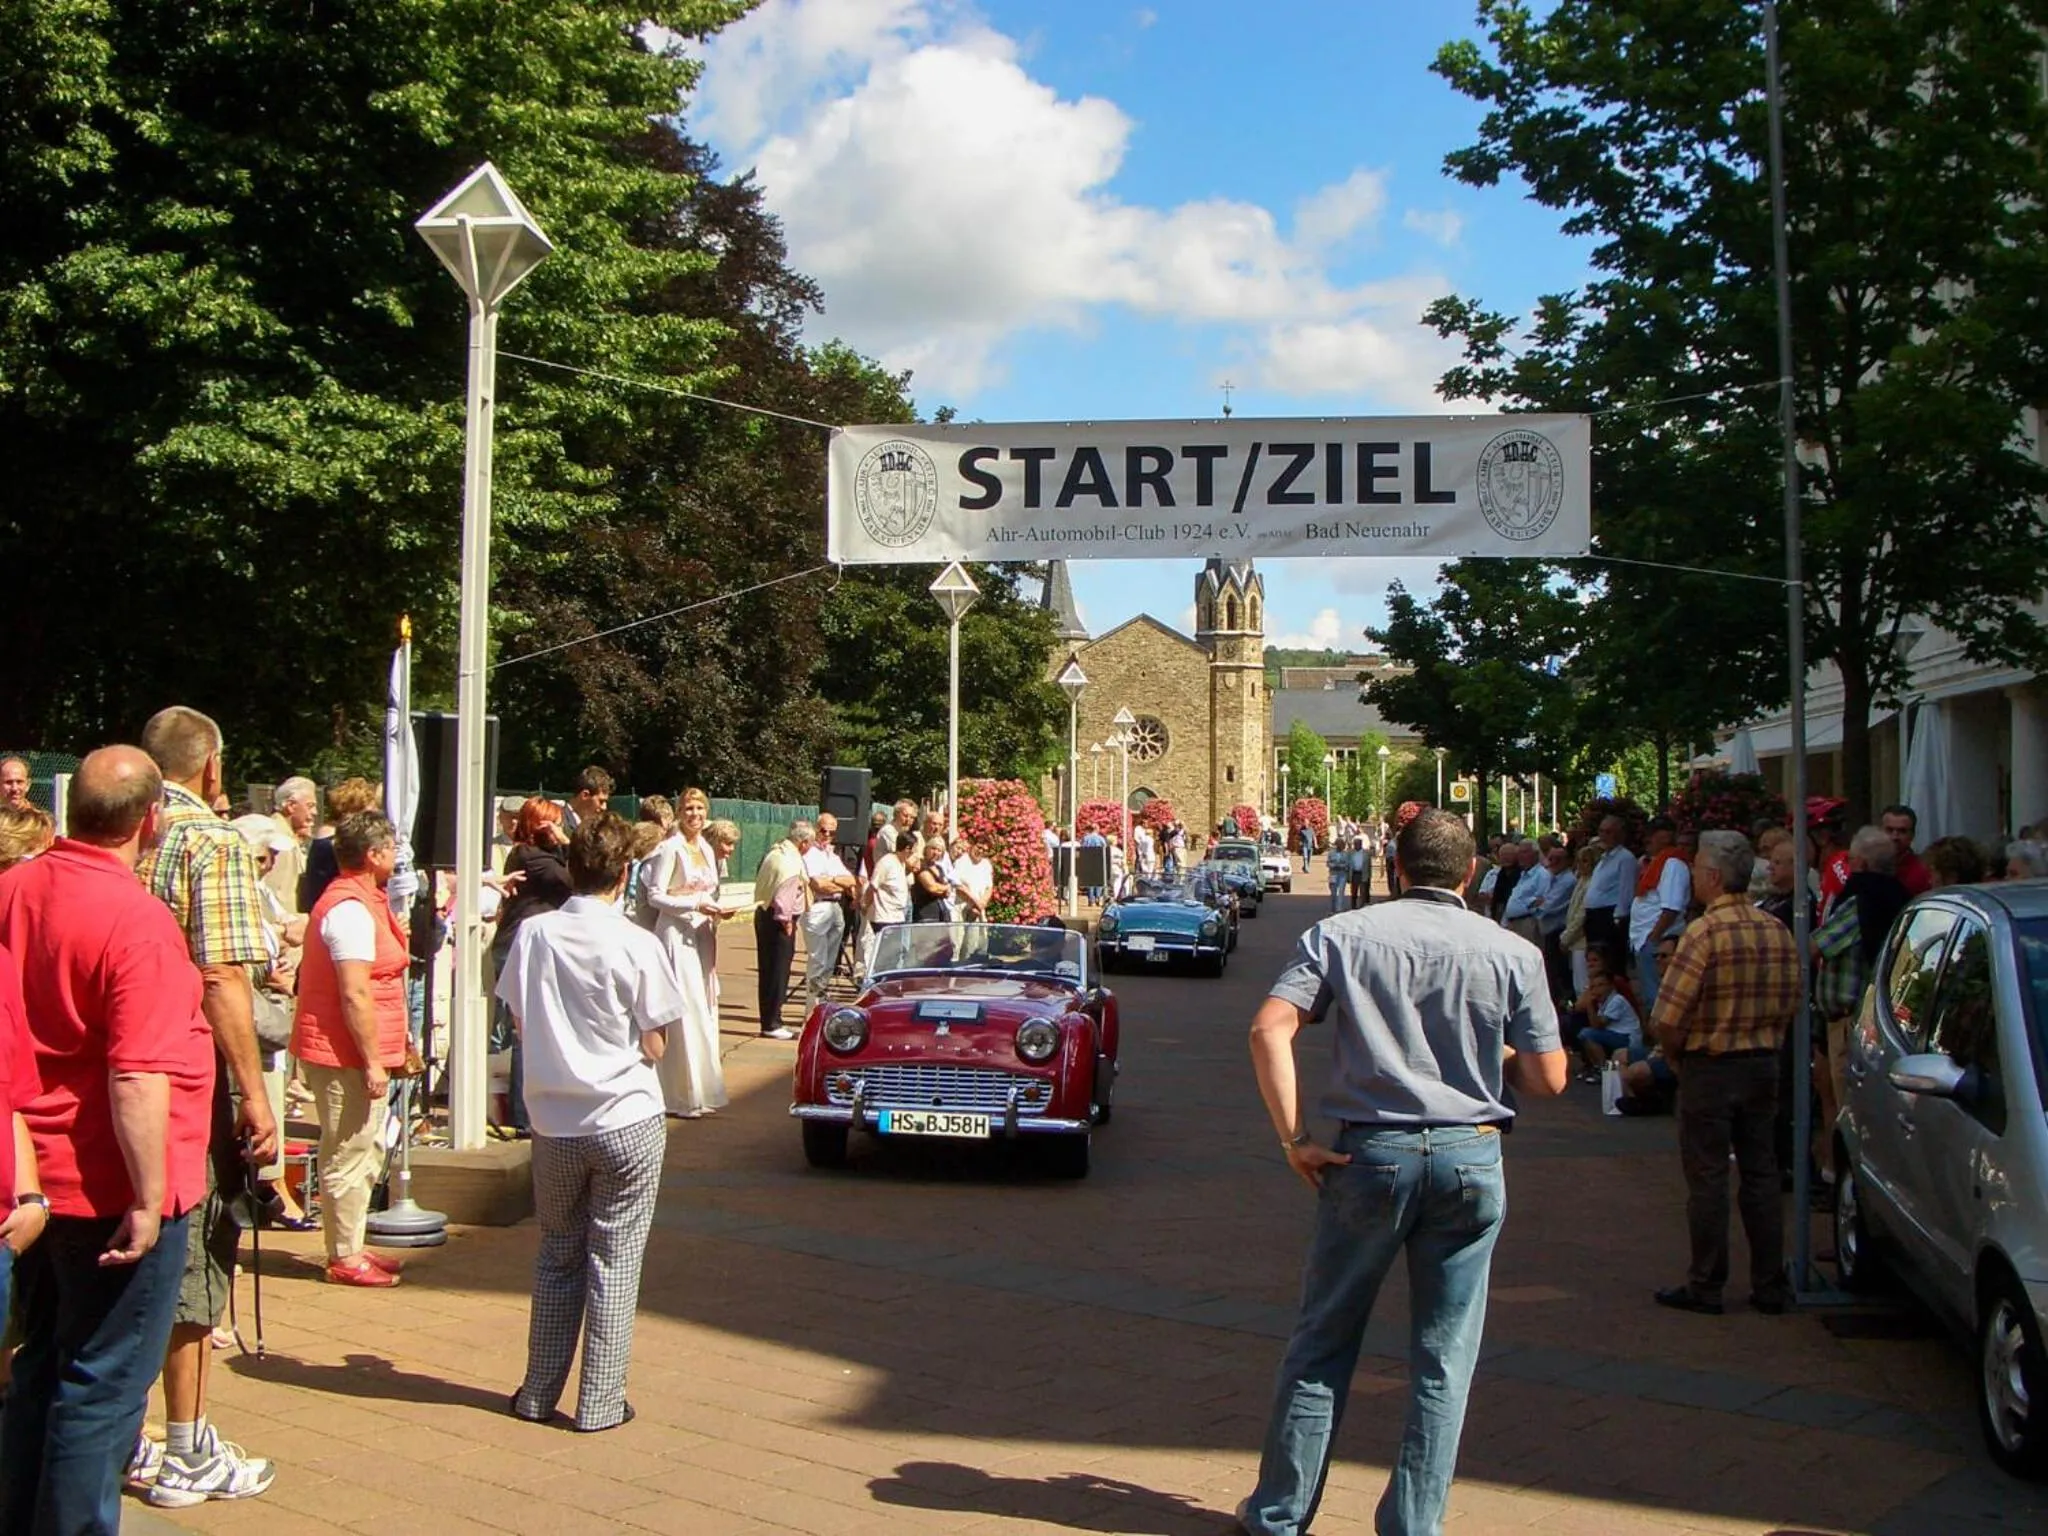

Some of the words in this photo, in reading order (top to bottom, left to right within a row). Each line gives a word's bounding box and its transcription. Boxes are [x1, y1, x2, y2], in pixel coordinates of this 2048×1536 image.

[959, 442, 1456, 514] START/ZIEL
[986, 523, 1166, 542] Ahr-Automobil-Club
[1172, 522, 1212, 540] 1924
[1305, 522, 1340, 539] Bad
[1345, 521, 1431, 539] Neuenahr
